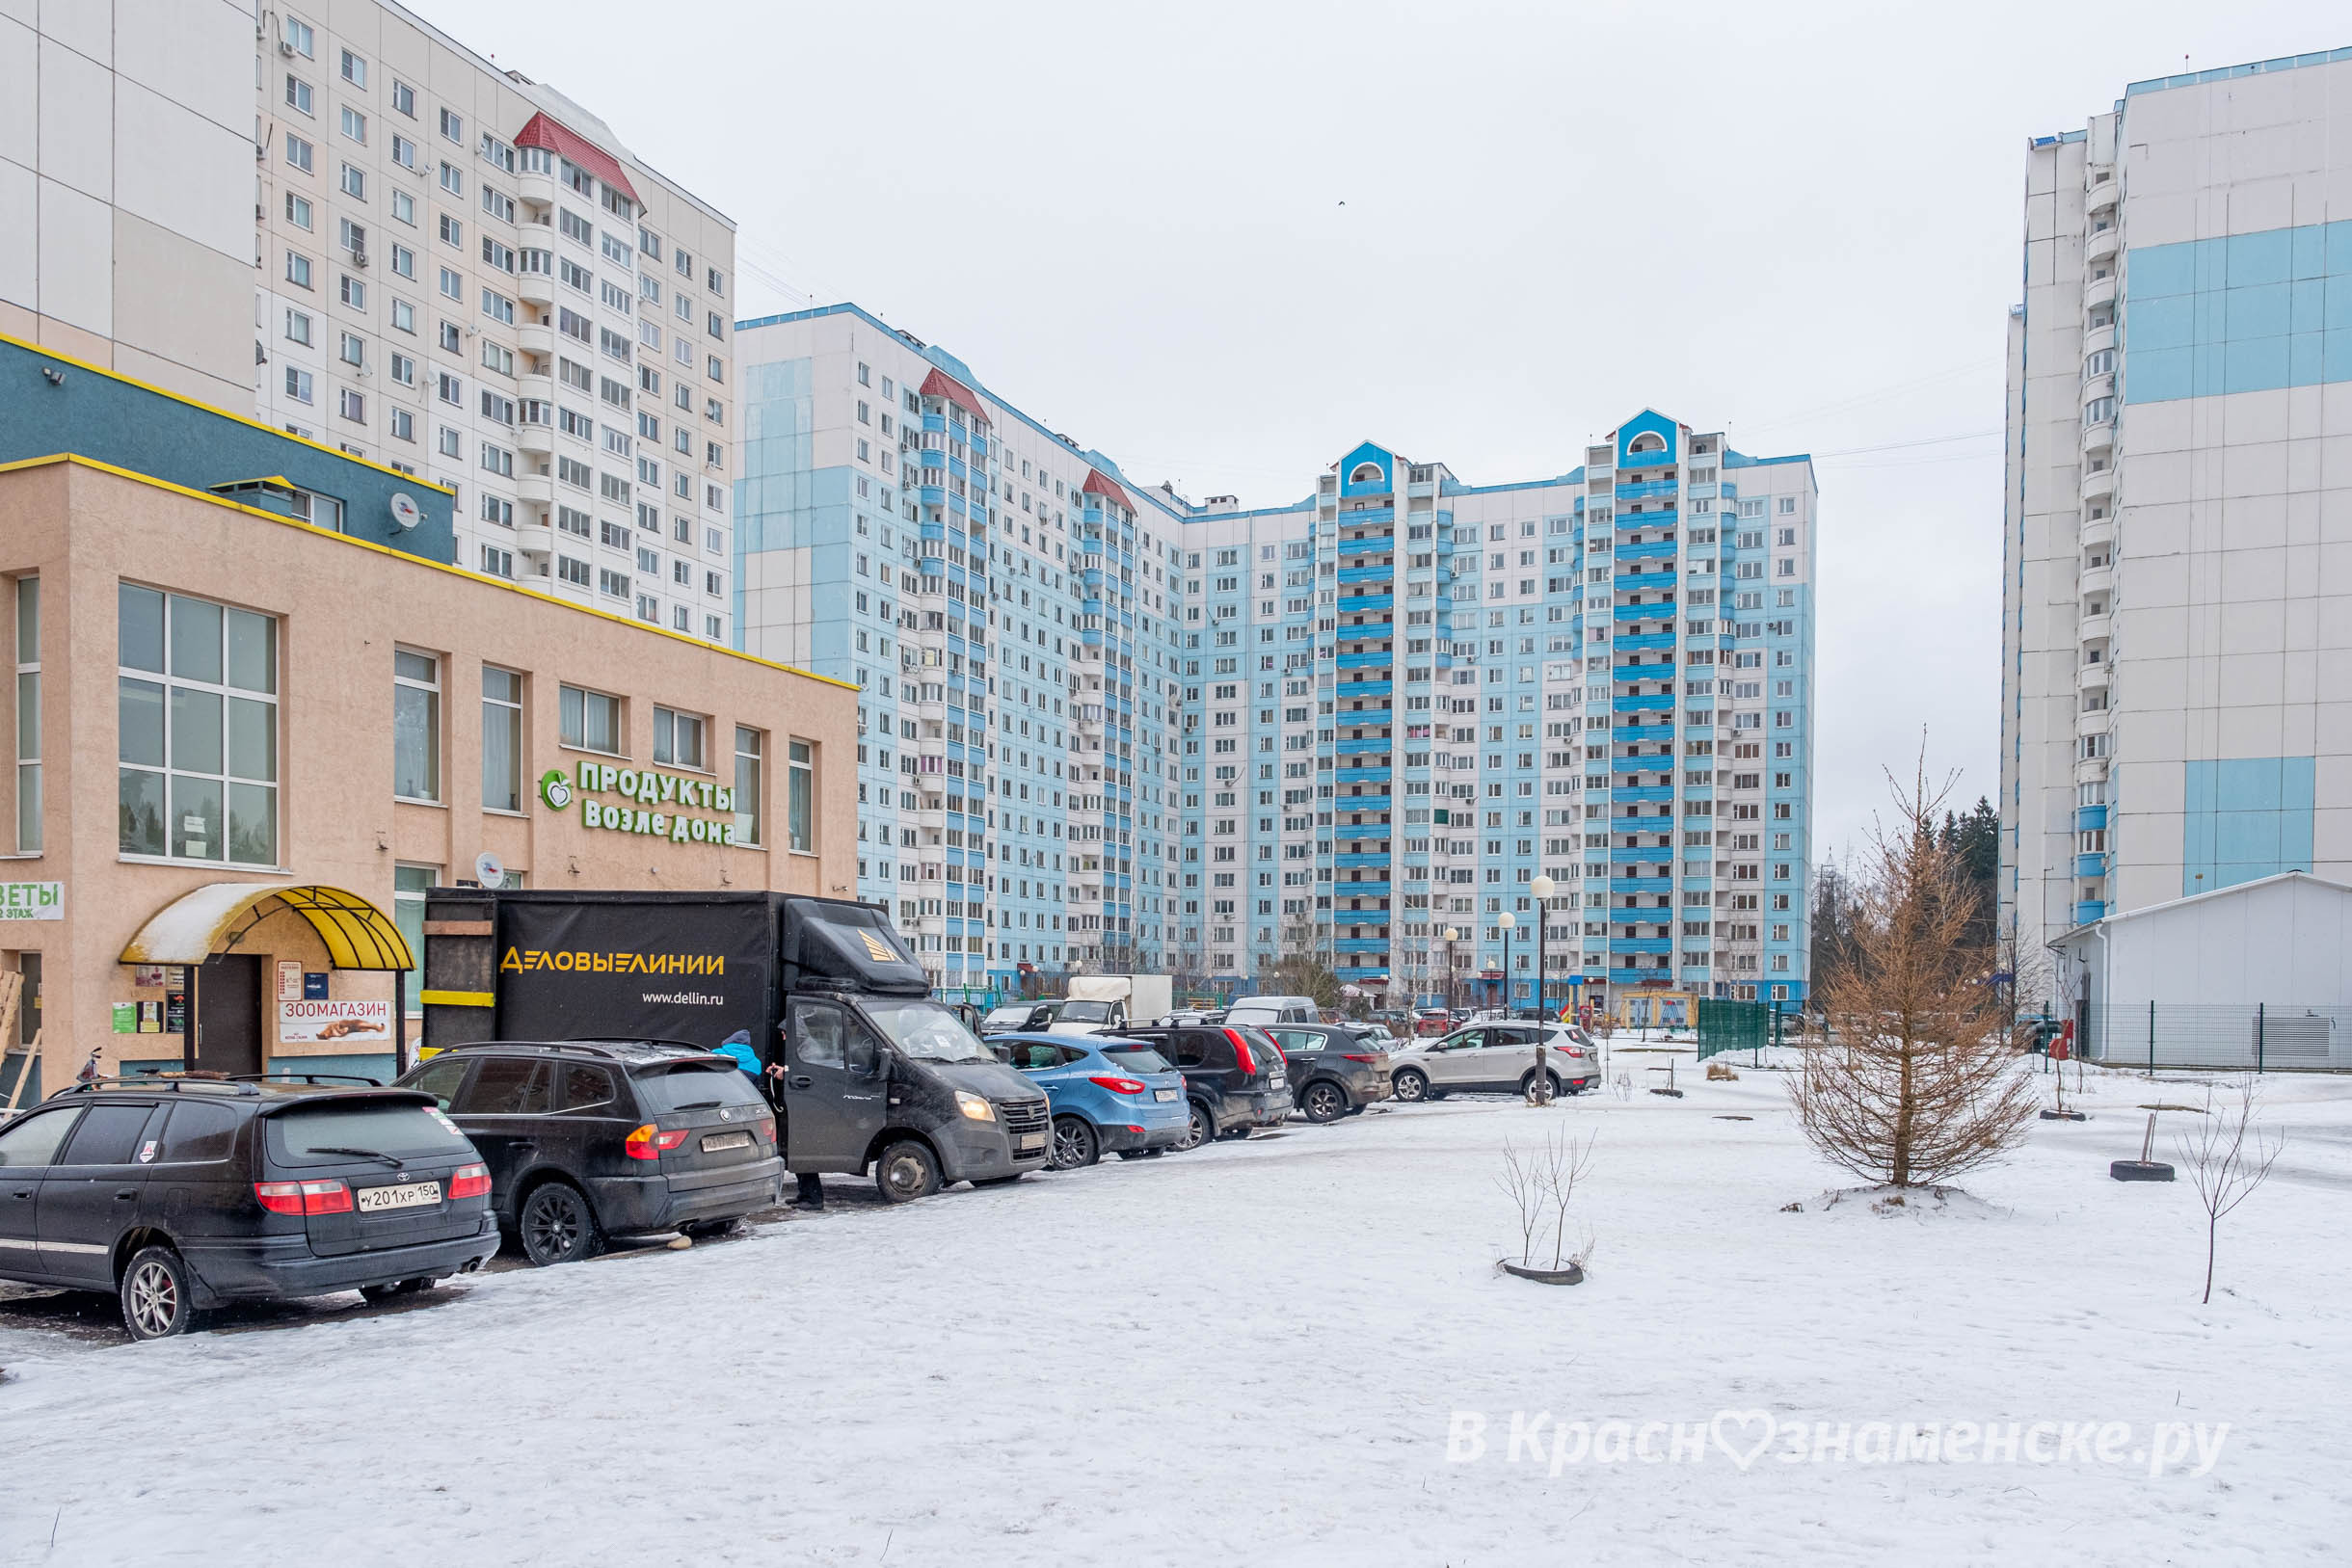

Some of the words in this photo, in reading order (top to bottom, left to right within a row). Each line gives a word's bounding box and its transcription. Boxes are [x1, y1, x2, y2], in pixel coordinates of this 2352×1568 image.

[577, 760, 735, 811] ПРОДУКТЫ
[582, 798, 665, 836] Возле
[285, 1003, 386, 1017] ЗООМАГАЗИН
[642, 992, 724, 1006] www.dellin.ru
